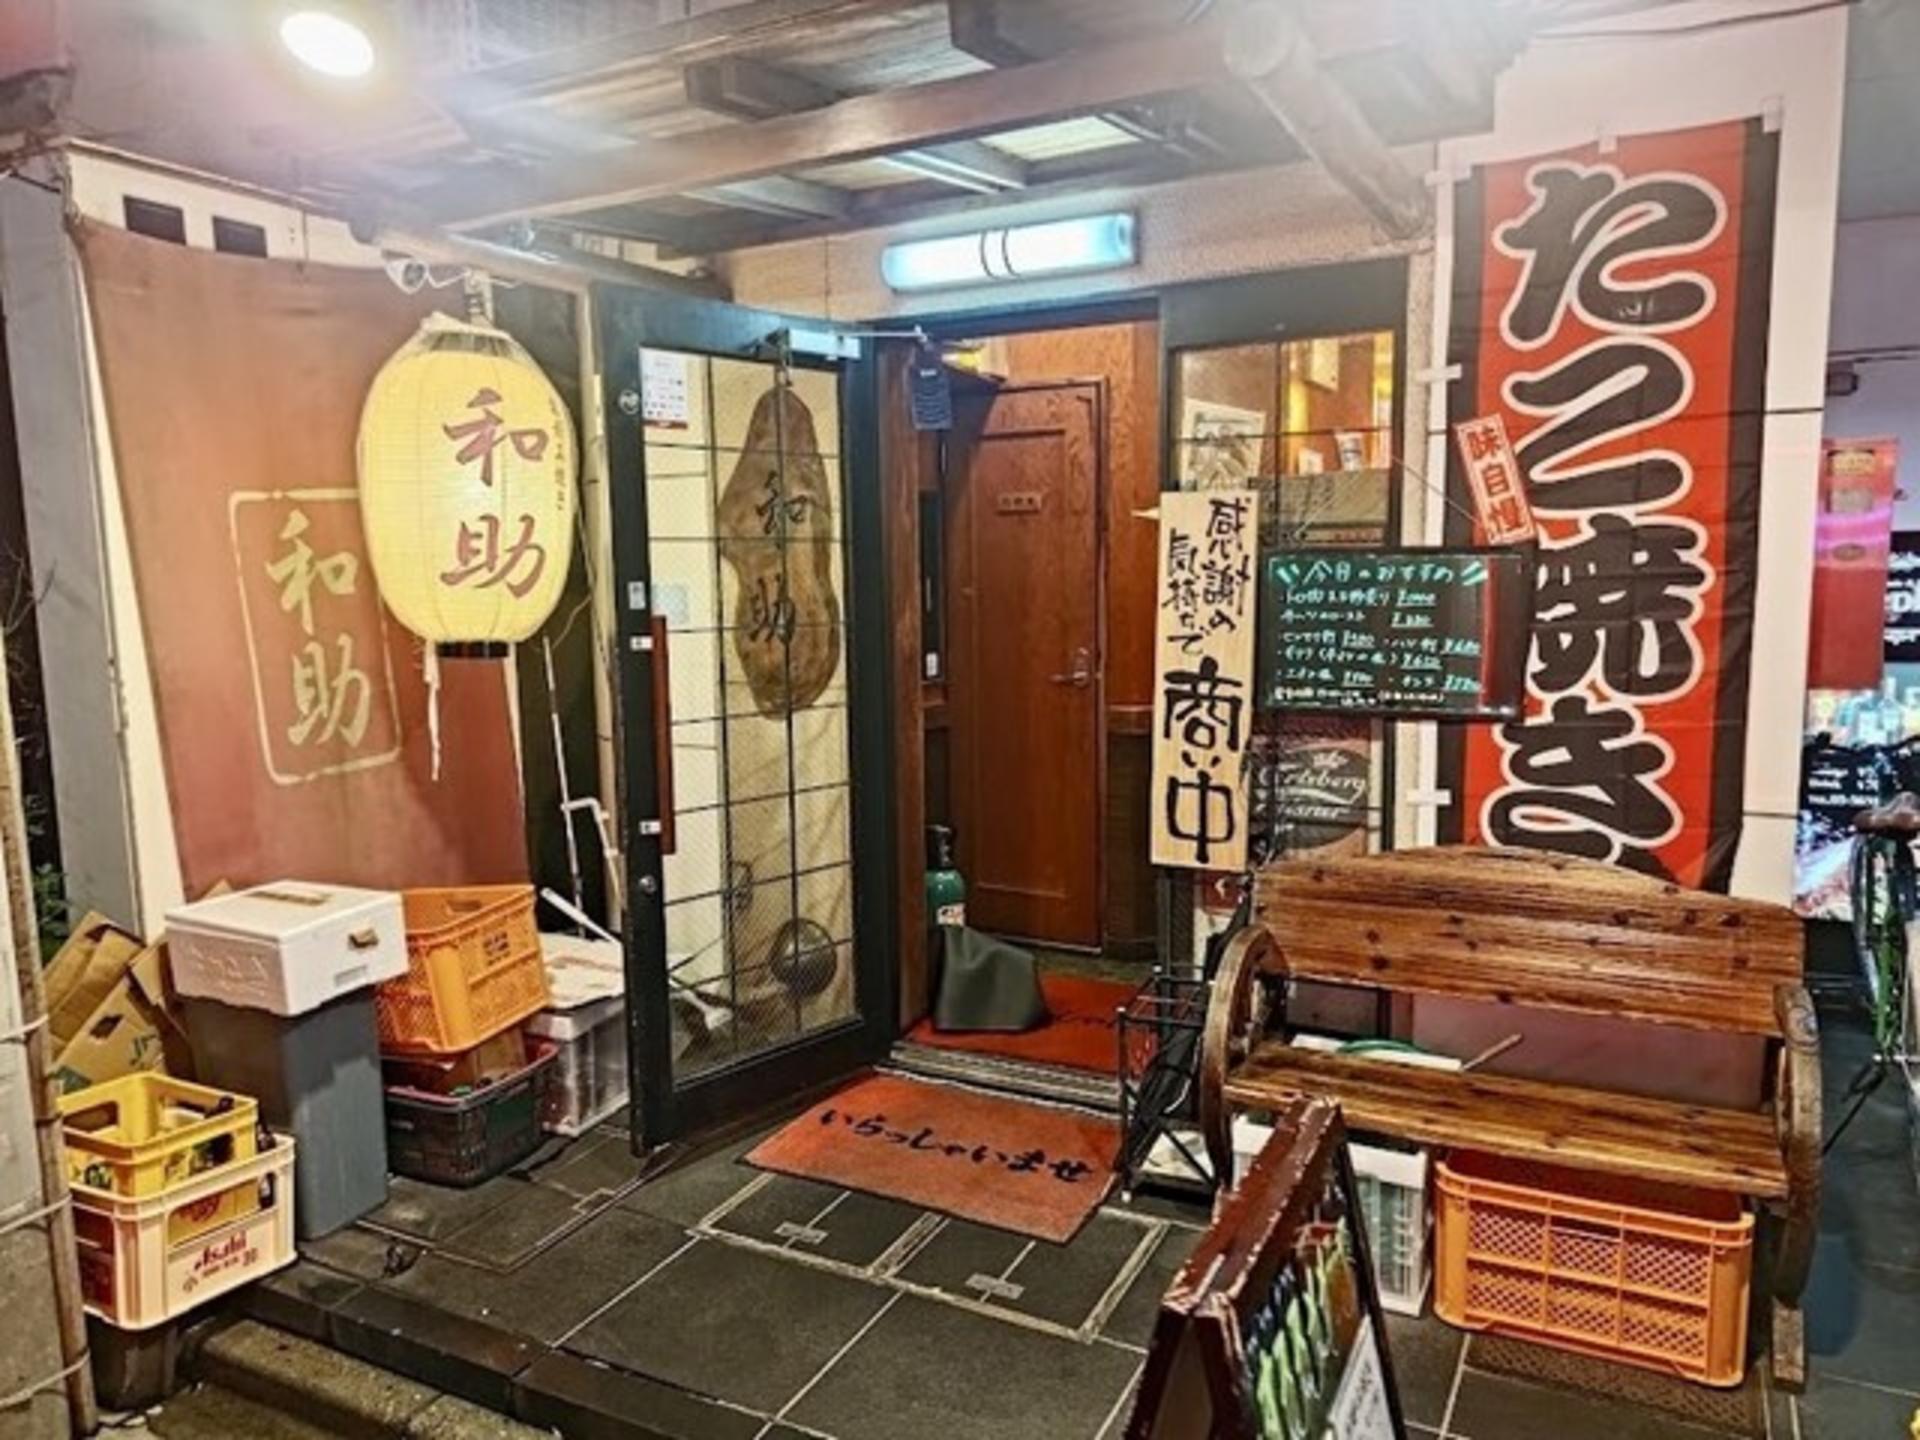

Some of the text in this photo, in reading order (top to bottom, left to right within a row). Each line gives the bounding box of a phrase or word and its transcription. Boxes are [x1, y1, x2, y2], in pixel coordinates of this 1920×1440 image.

[439, 387, 549, 598] 和助
[1202, 497, 1251, 631] 感謝の
[1493, 161, 1727, 864] たこ焼き
[265, 508, 371, 747] 和助
[1163, 656, 1243, 864] 商い中
[820, 1109, 1094, 1183] いらっしゃいませ
